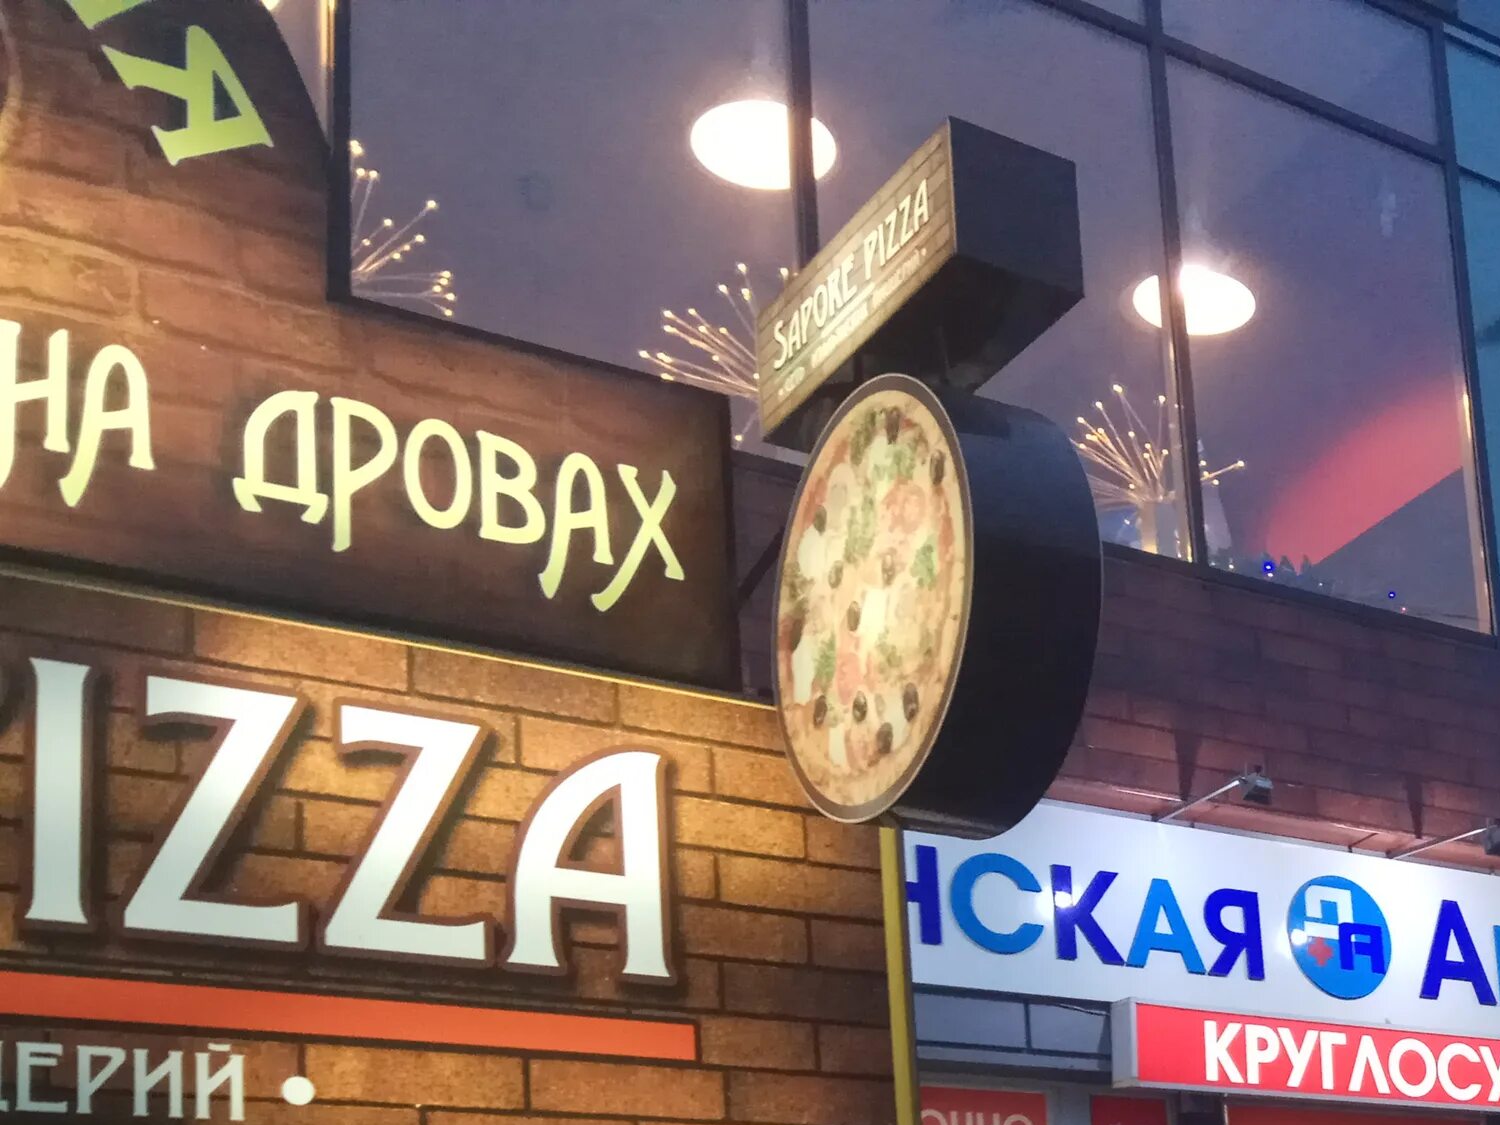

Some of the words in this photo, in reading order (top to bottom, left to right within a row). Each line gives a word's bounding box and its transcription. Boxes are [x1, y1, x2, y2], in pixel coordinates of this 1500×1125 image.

[773, 253, 859, 370] SAPORE
[863, 178, 930, 281] PIZZA
[232, 391, 685, 612] ДРОВАХ
[0, 1040, 245, 1121] ЕРИЙ
